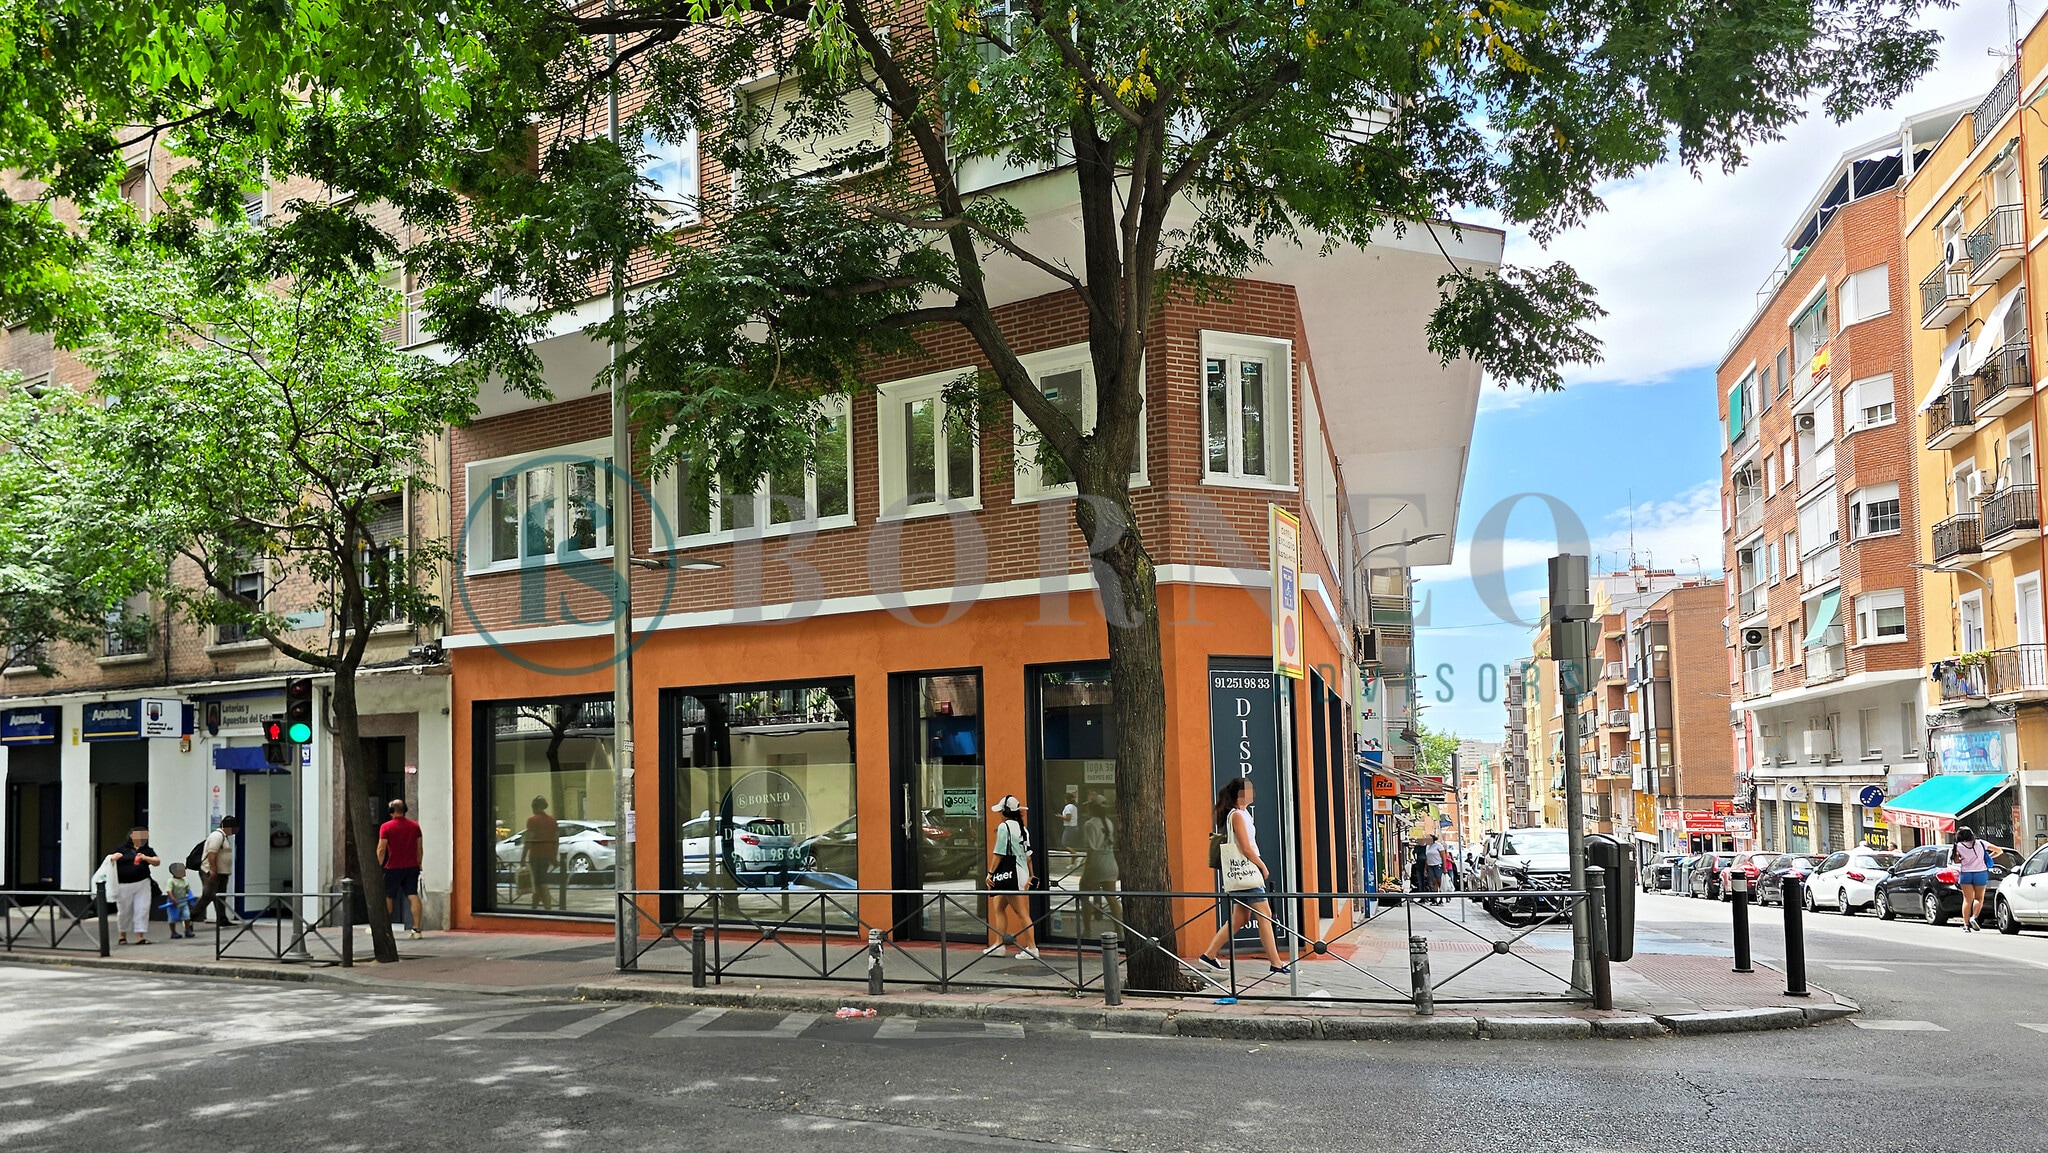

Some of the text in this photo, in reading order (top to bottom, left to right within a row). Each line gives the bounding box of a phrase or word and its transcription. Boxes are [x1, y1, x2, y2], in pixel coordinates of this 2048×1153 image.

[1214, 677, 1270, 690] 91 251 98 33
[9, 713, 45, 727] ADMIRAL
[92, 707, 132, 721] ADMIRAL
[223, 712, 273, 727] Apuestas del Esta
[749, 792, 790, 804] BORNEO
[724, 821, 807, 841] DPONIBLE
[748, 848, 766, 862] 251
[770, 847, 784, 861] 98
[788, 846, 802, 860] 33
